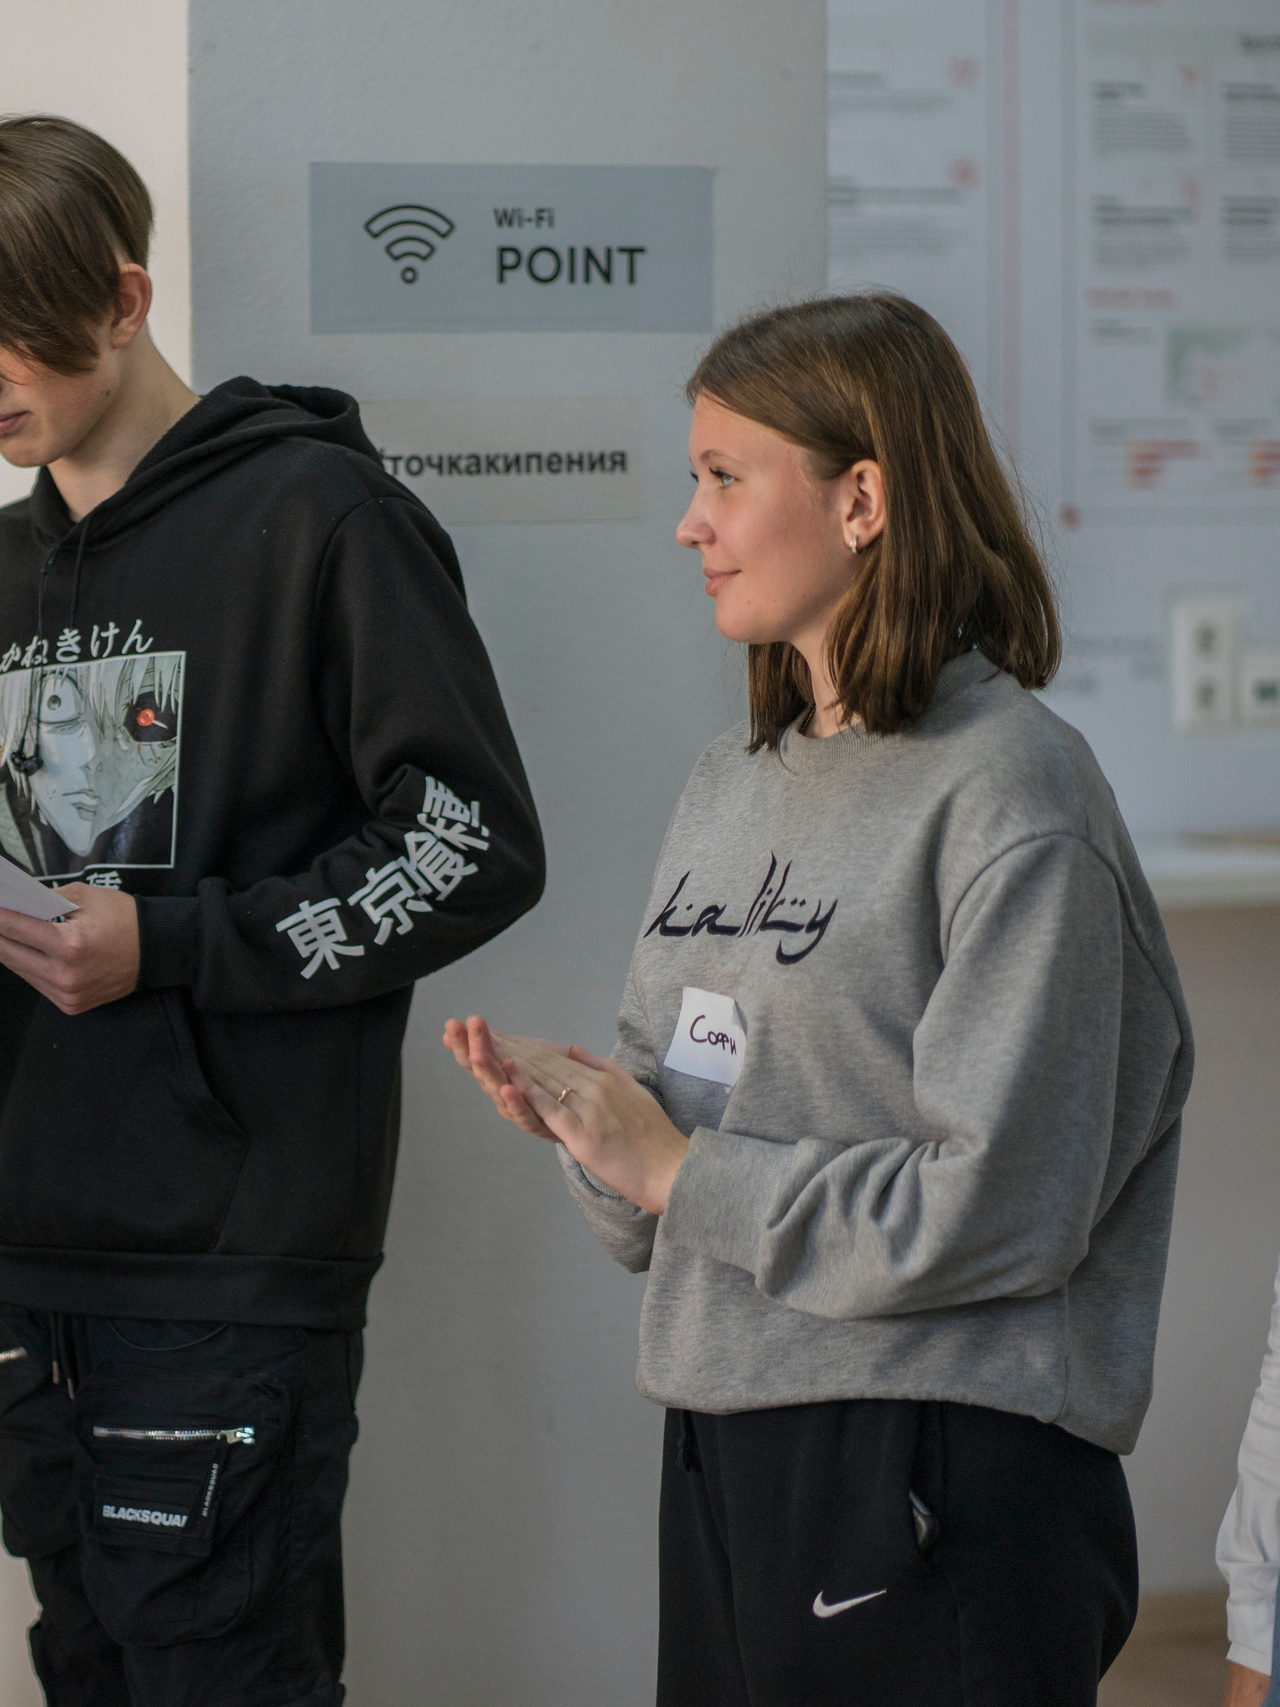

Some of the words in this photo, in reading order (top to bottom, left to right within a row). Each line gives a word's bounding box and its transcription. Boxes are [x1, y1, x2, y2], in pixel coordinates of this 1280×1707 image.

[493, 207, 555, 229] Wi-Fi
[496, 246, 647, 285] POINT
[379, 447, 628, 477] точкакипения
